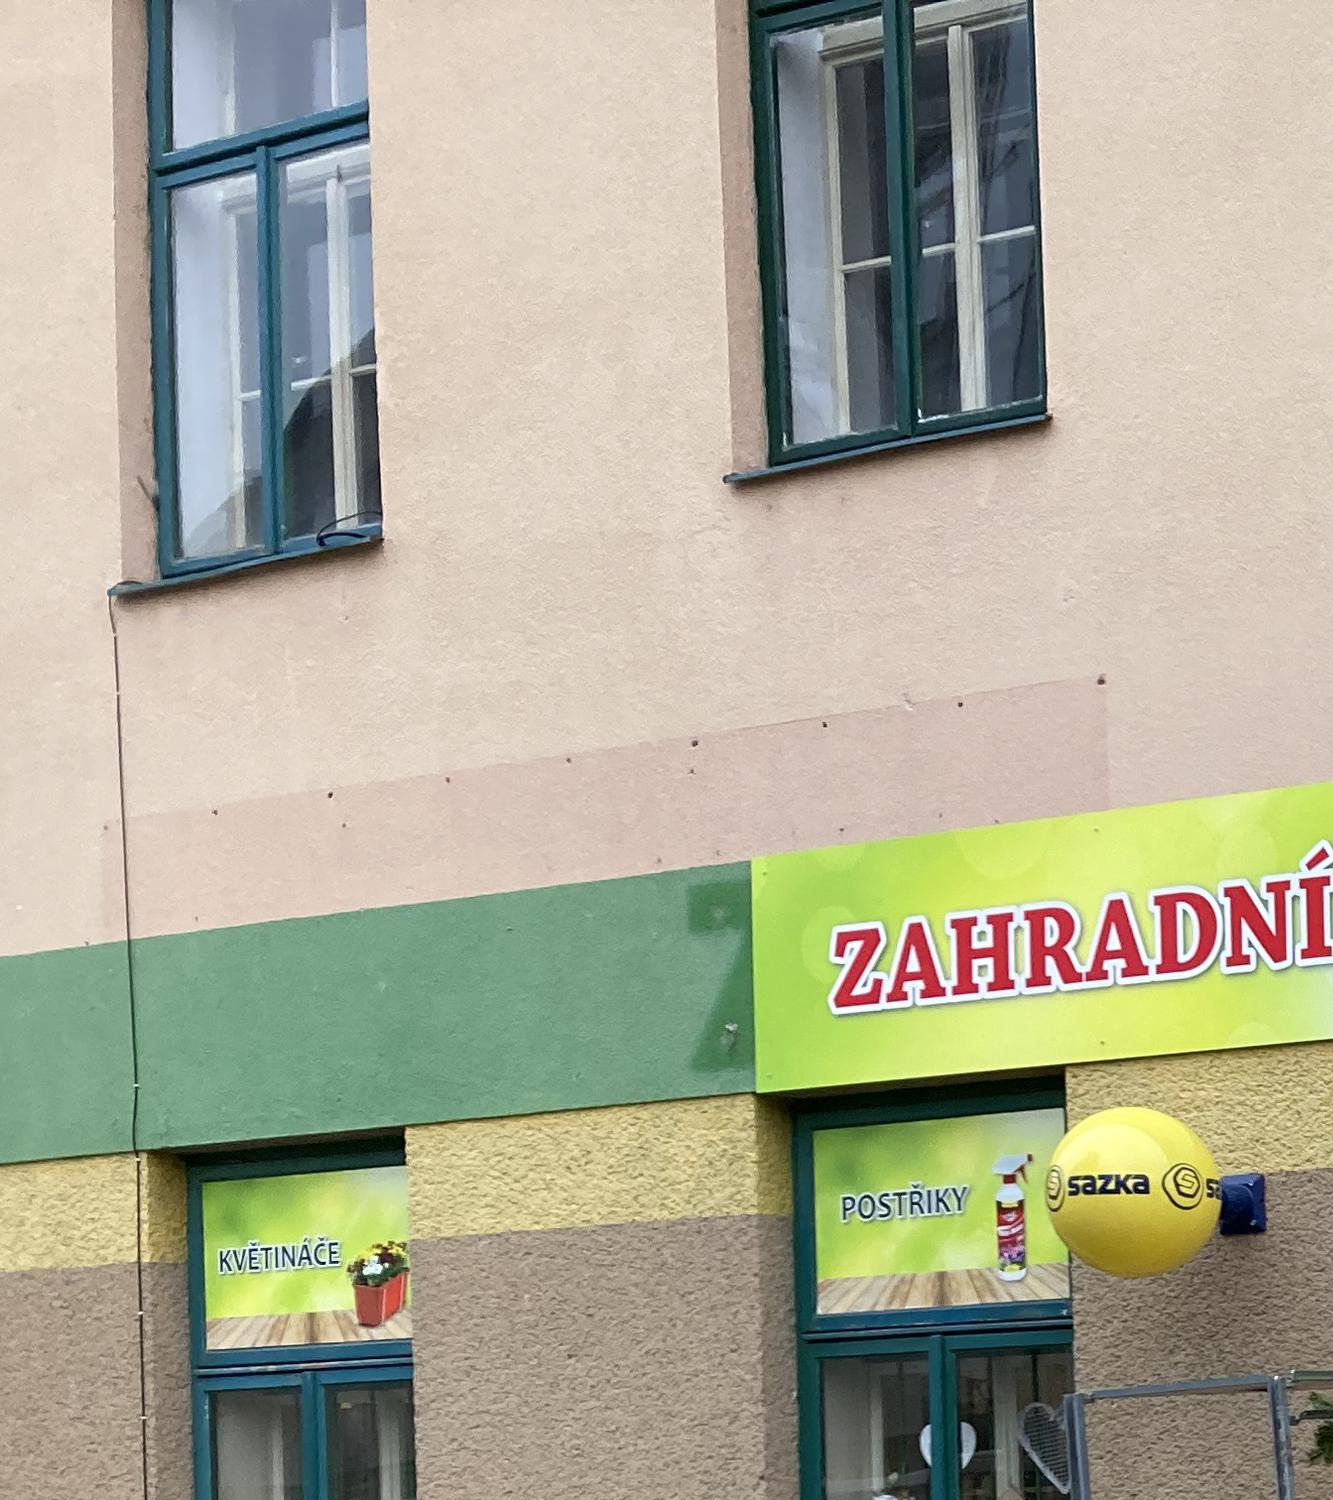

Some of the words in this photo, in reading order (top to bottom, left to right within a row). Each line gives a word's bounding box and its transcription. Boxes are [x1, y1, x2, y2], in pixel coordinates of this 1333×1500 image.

[841, 1184, 969, 1222] POSTŘIKY
[1068, 1174, 1150, 1196] sazka
[219, 1236, 340, 1273] KVĚTINÁČE
